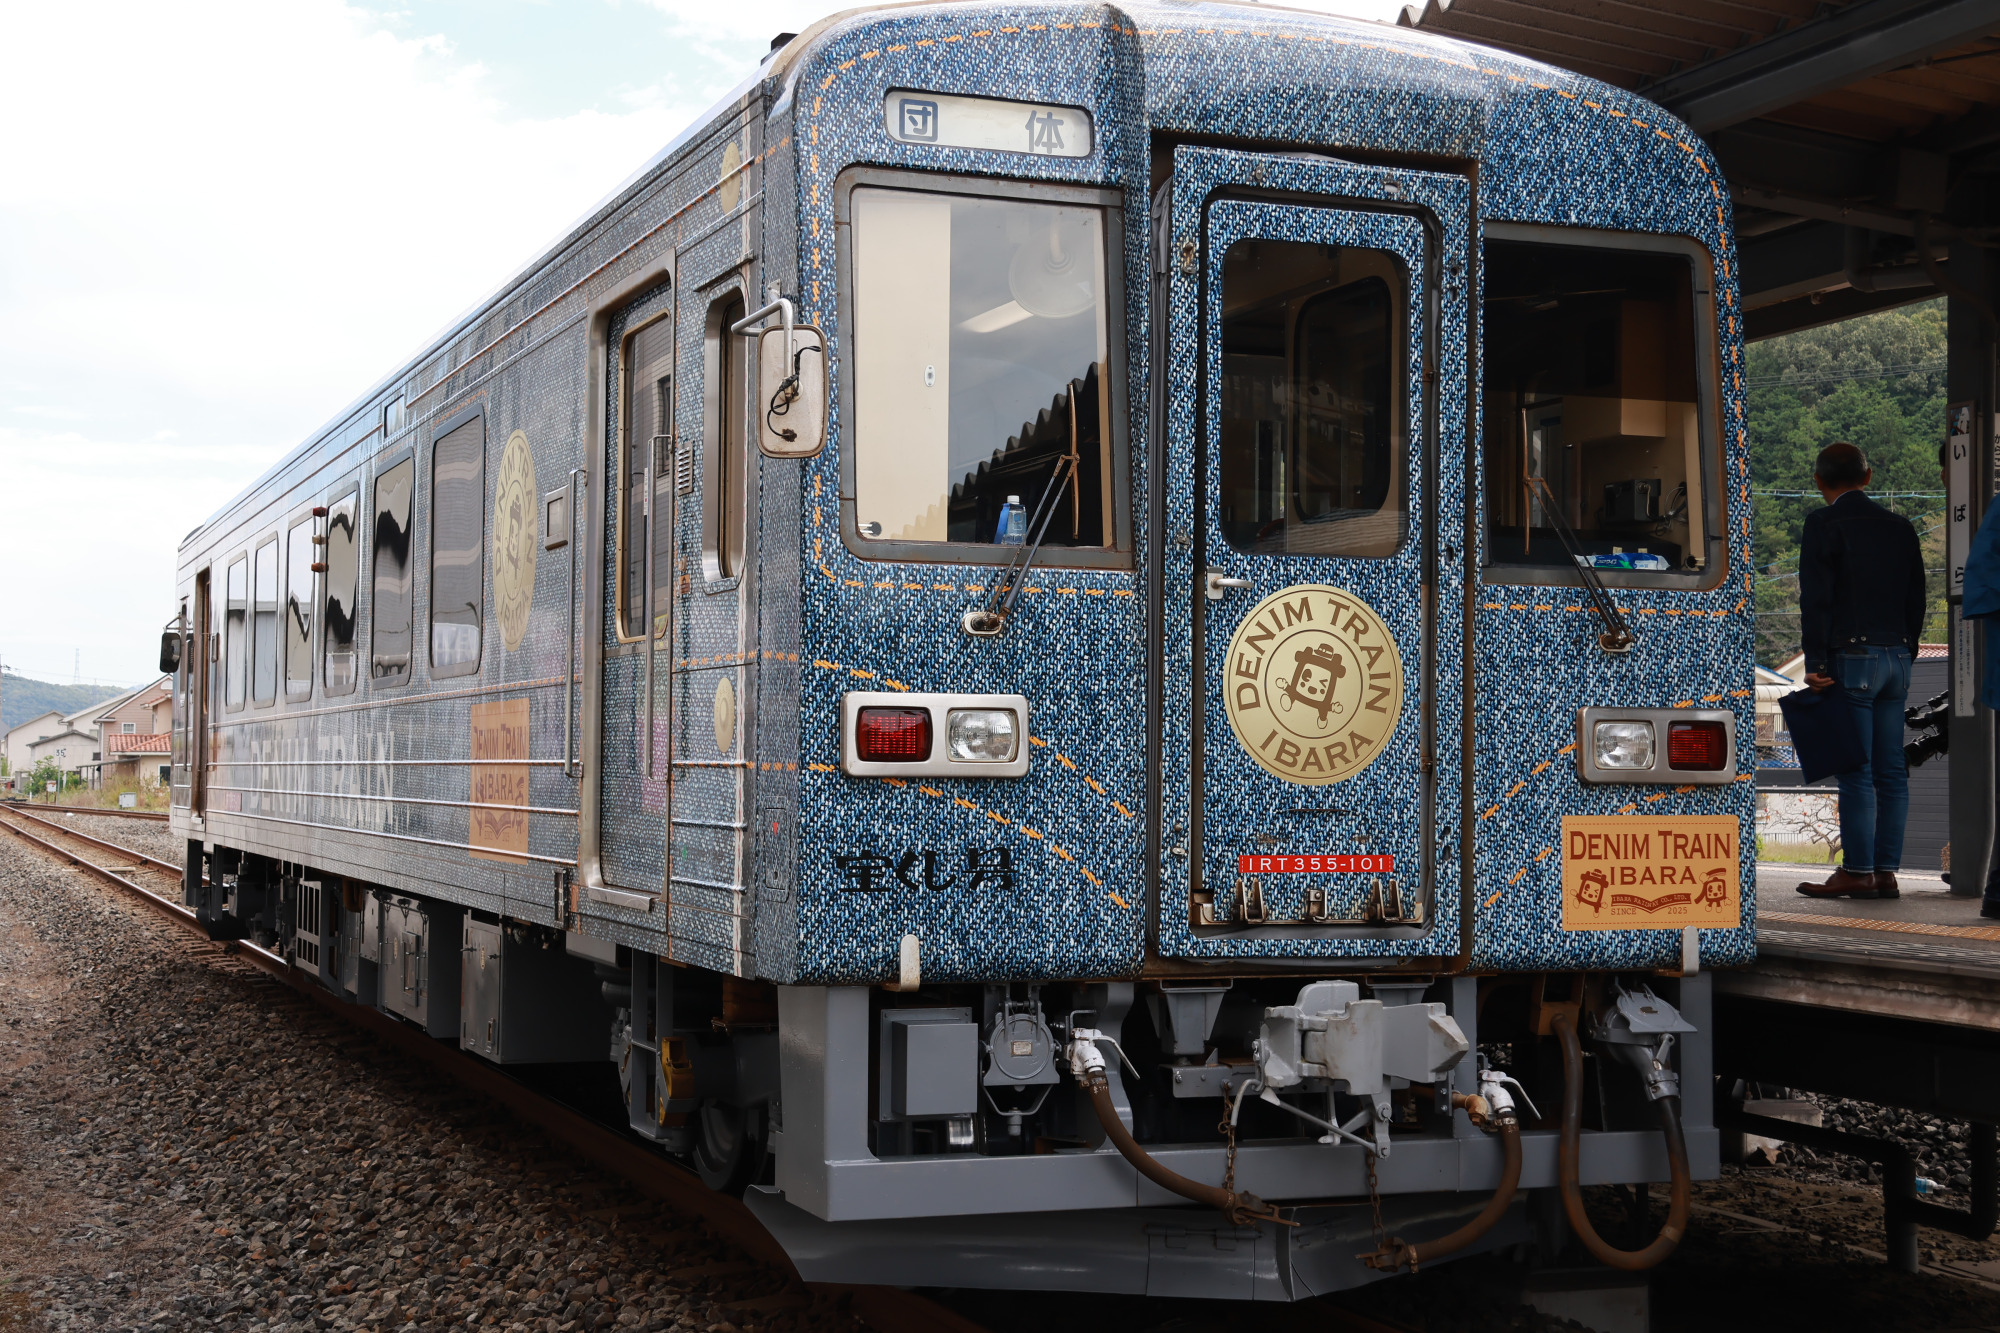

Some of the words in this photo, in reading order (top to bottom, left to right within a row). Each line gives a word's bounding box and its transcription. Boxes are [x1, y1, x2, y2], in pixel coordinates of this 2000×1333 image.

[496, 446, 515, 577] DENIM
[518, 443, 533, 564] TRAIN
[1235, 596, 1314, 712] DENIM
[1328, 598, 1391, 714] TRAIN
[501, 724, 526, 760] TRAIN
[1259, 729, 1374, 772] IBARA
[251, 738, 308, 815] DENIM
[317, 731, 394, 825] TRAIN
[485, 773, 513, 800] IBARA
[1570, 831, 1650, 860] DENIM
[1658, 830, 1731, 859] TRAIN
[1610, 866, 1697, 885] IBARA
[1634, 897, 1660, 907] RAILWAY
